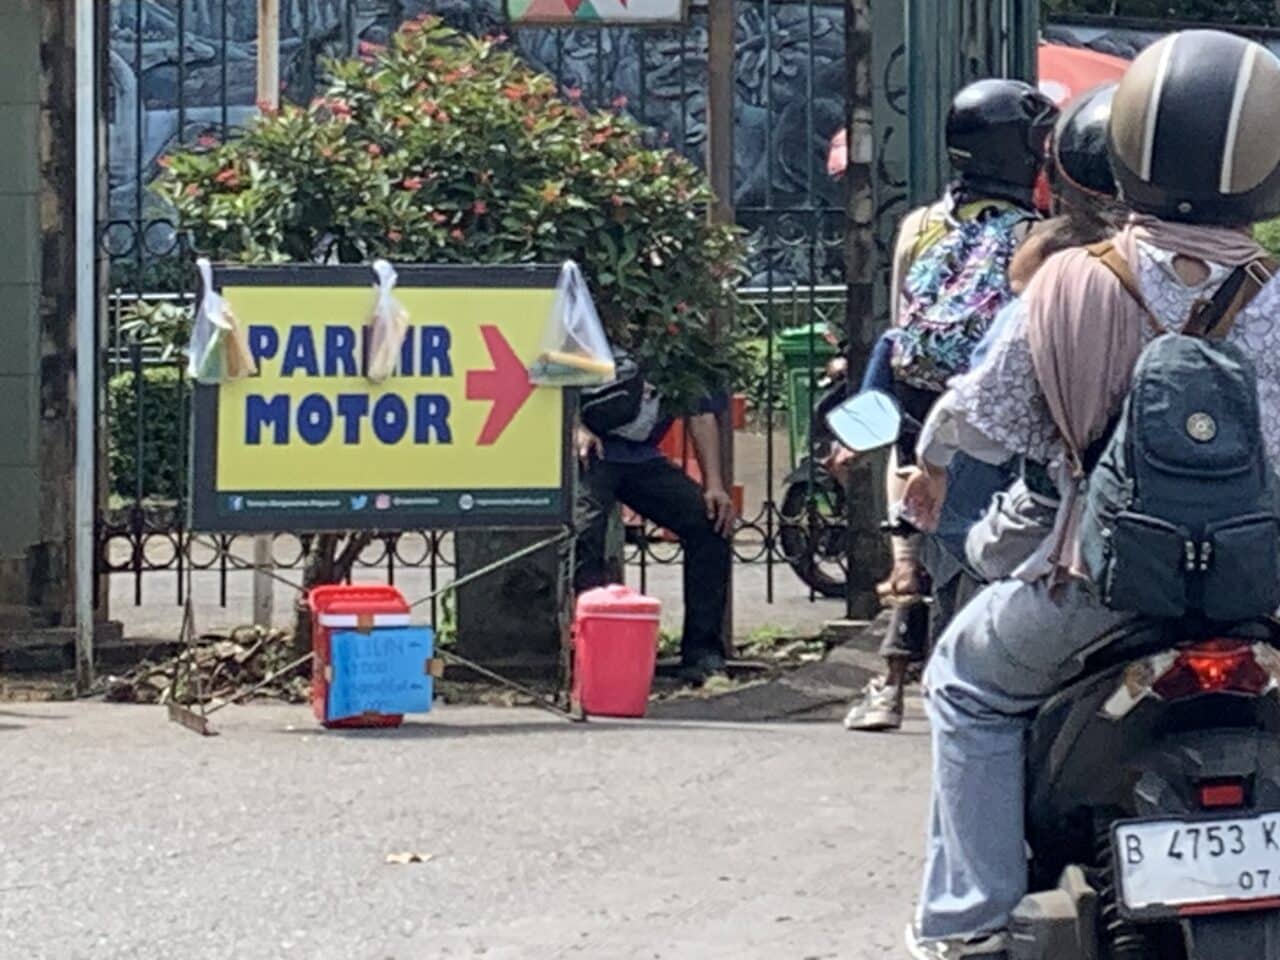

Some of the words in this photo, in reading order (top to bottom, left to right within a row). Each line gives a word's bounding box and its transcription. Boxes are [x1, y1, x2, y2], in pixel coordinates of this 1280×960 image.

[244, 392, 453, 446] MOTOR
[1125, 834, 1144, 865] B
[1167, 824, 1246, 860] 4753
